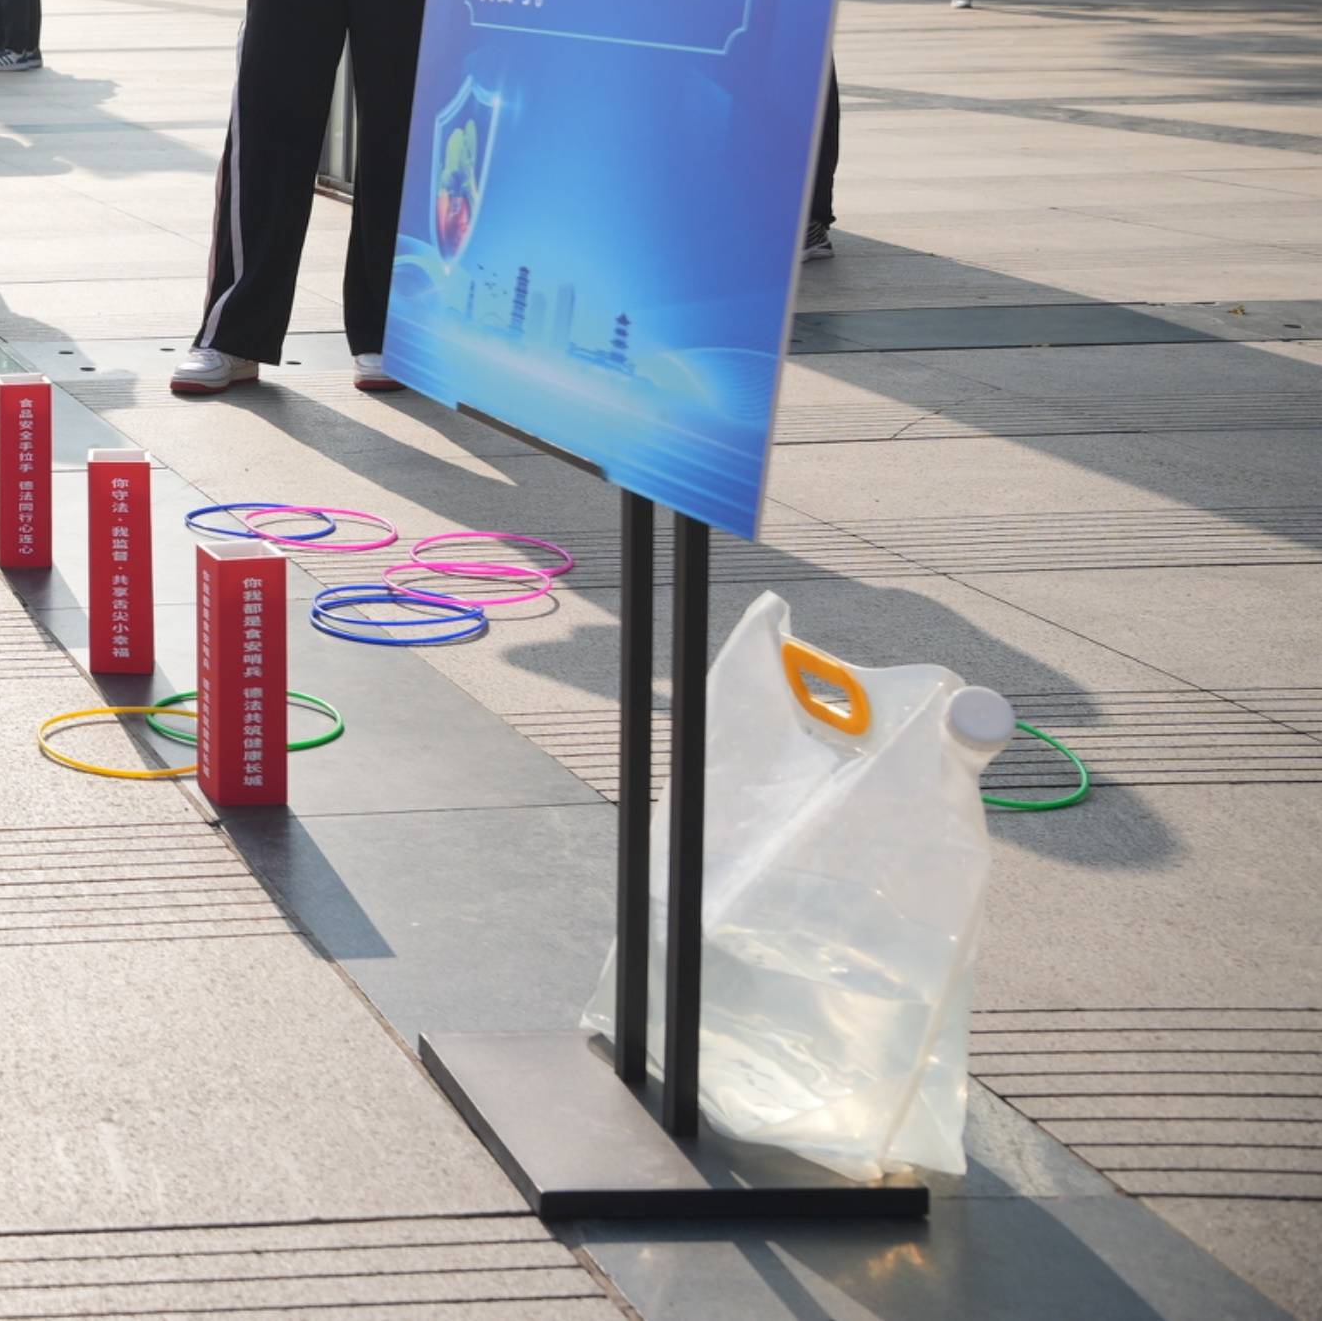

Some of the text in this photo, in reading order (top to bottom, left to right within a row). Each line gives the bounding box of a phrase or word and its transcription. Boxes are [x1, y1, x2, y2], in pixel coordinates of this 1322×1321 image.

[18, 398, 34, 556] 食品安全手拉手 德法同行心连心
[243, 577, 263, 787] 你我都是食安哨兵 德法共筑健康长城
